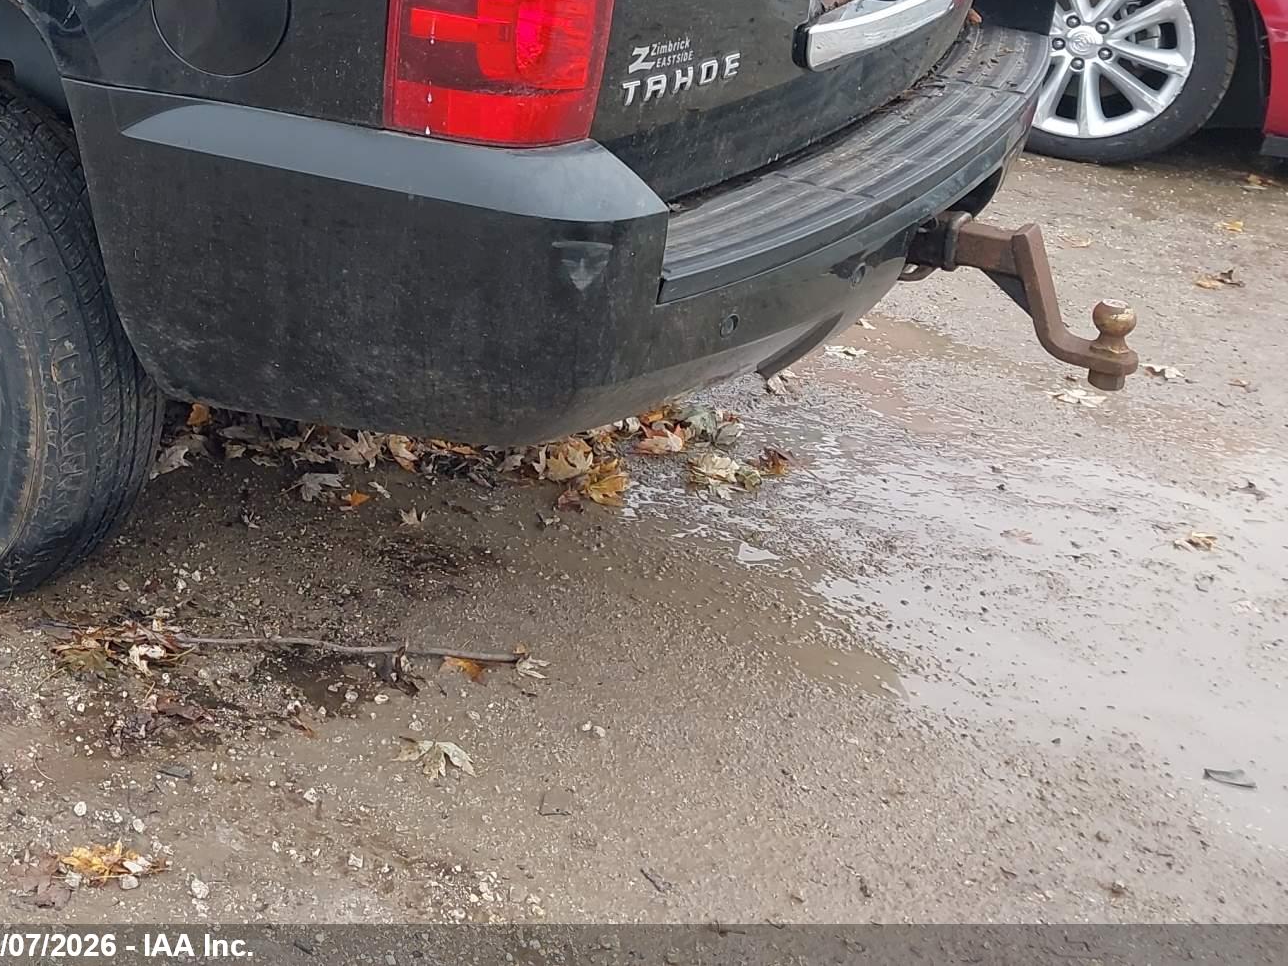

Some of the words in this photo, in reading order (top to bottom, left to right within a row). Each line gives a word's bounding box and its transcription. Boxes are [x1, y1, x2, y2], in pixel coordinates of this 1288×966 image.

[650, 37, 691, 57] Zimbrick
[655, 50, 694, 69] EASTSIDE
[622, 52, 741, 107] TAHOE
